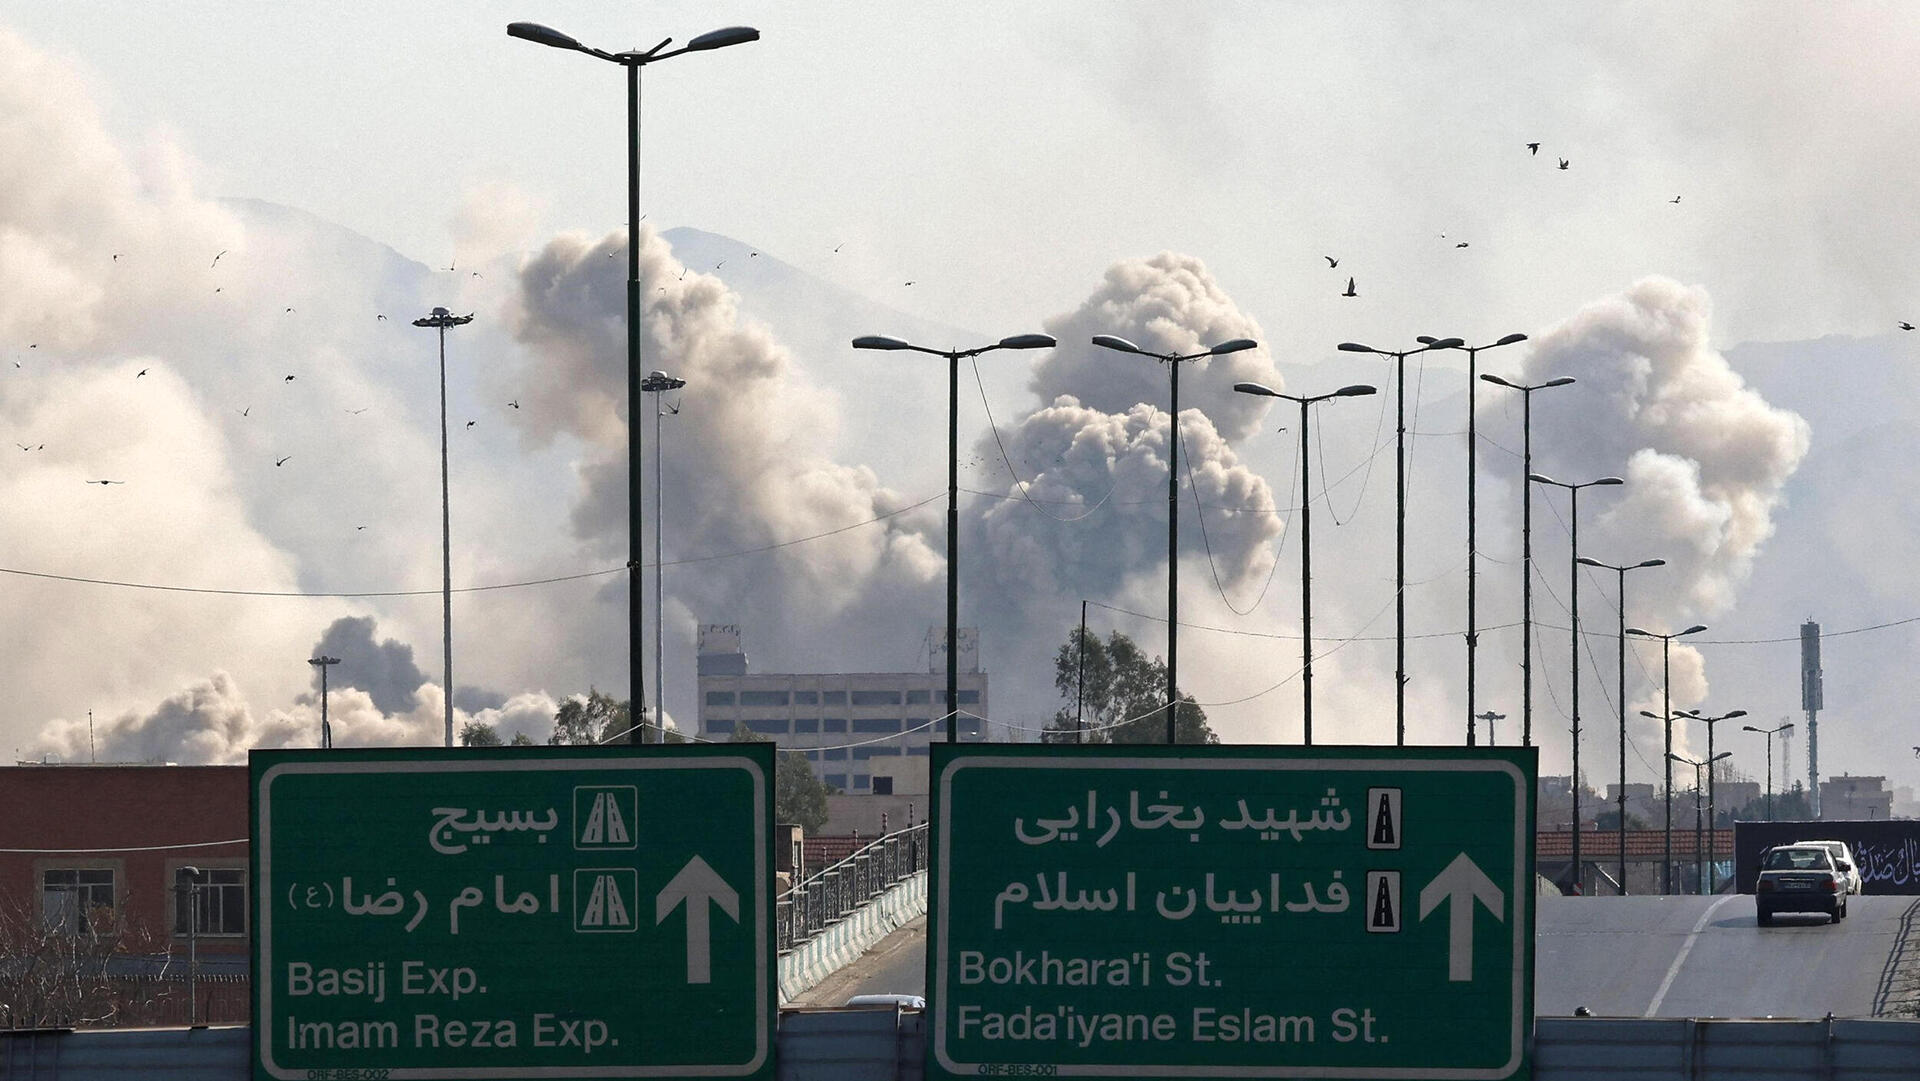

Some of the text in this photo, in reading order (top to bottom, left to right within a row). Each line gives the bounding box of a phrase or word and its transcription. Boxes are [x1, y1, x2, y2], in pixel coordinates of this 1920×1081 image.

[429, 807, 559, 855] بسیج
[1015, 787, 1352, 848] شهید بخارایی
[450, 873, 559, 935] امام
[995, 870, 1350, 930] فداییان اسلام
[288, 960, 487, 1003] Basij Exp.
[959, 950, 1222, 987] Bokhara'i St.
[288, 1013, 619, 1054] Imam Reza Exp.
[958, 1005, 1389, 1048] Fada'iyane Eslam St.
